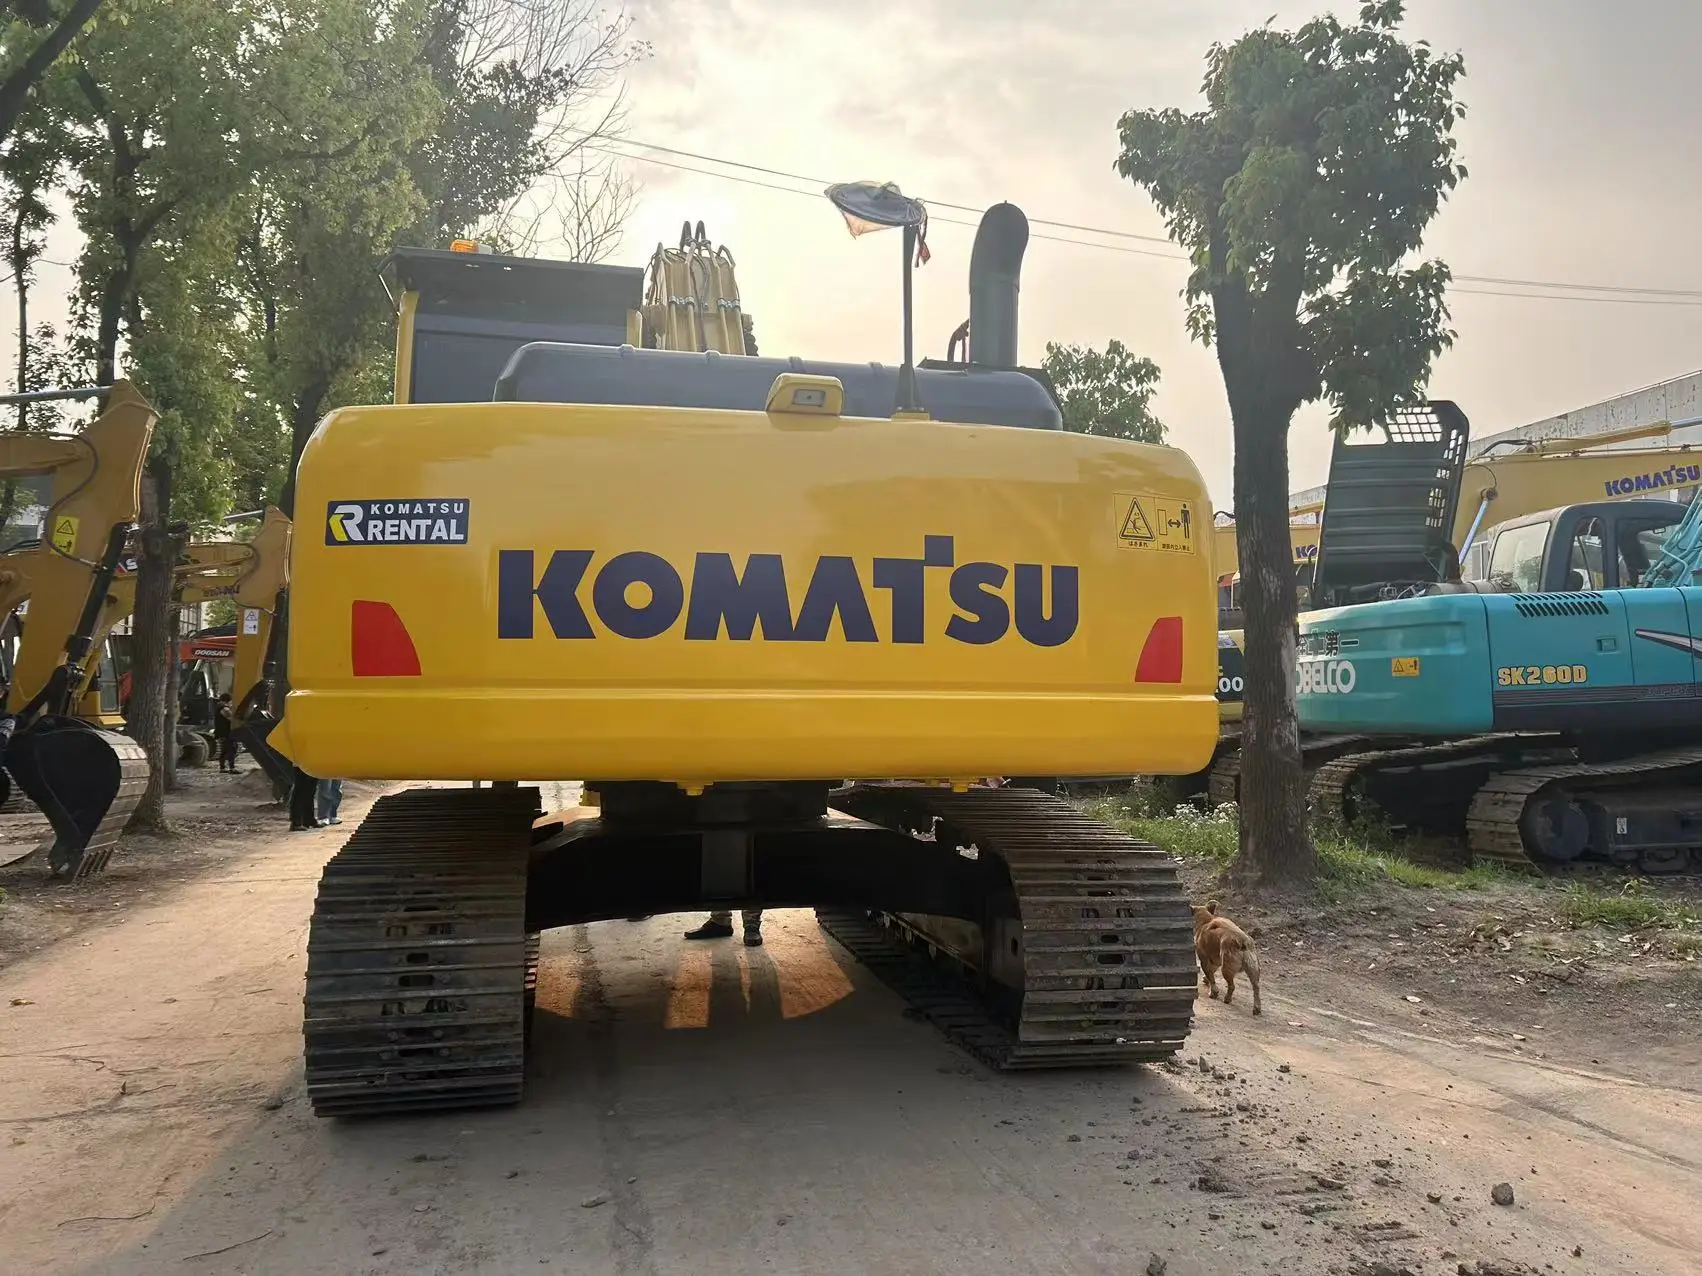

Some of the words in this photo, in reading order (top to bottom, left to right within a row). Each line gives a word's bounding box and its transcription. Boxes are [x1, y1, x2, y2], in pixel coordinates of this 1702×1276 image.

[1604, 465, 1701, 497] KOMATSU
[371, 502, 464, 515] KOMATSU
[367, 518, 464, 541] RENTAL
[497, 534, 1079, 647] KOMATSU
[194, 649, 231, 658] DOOSAN
[1216, 677, 1244, 693] 00
[1296, 660, 1356, 694] OBELCO
[1497, 664, 1588, 687] SK260D
